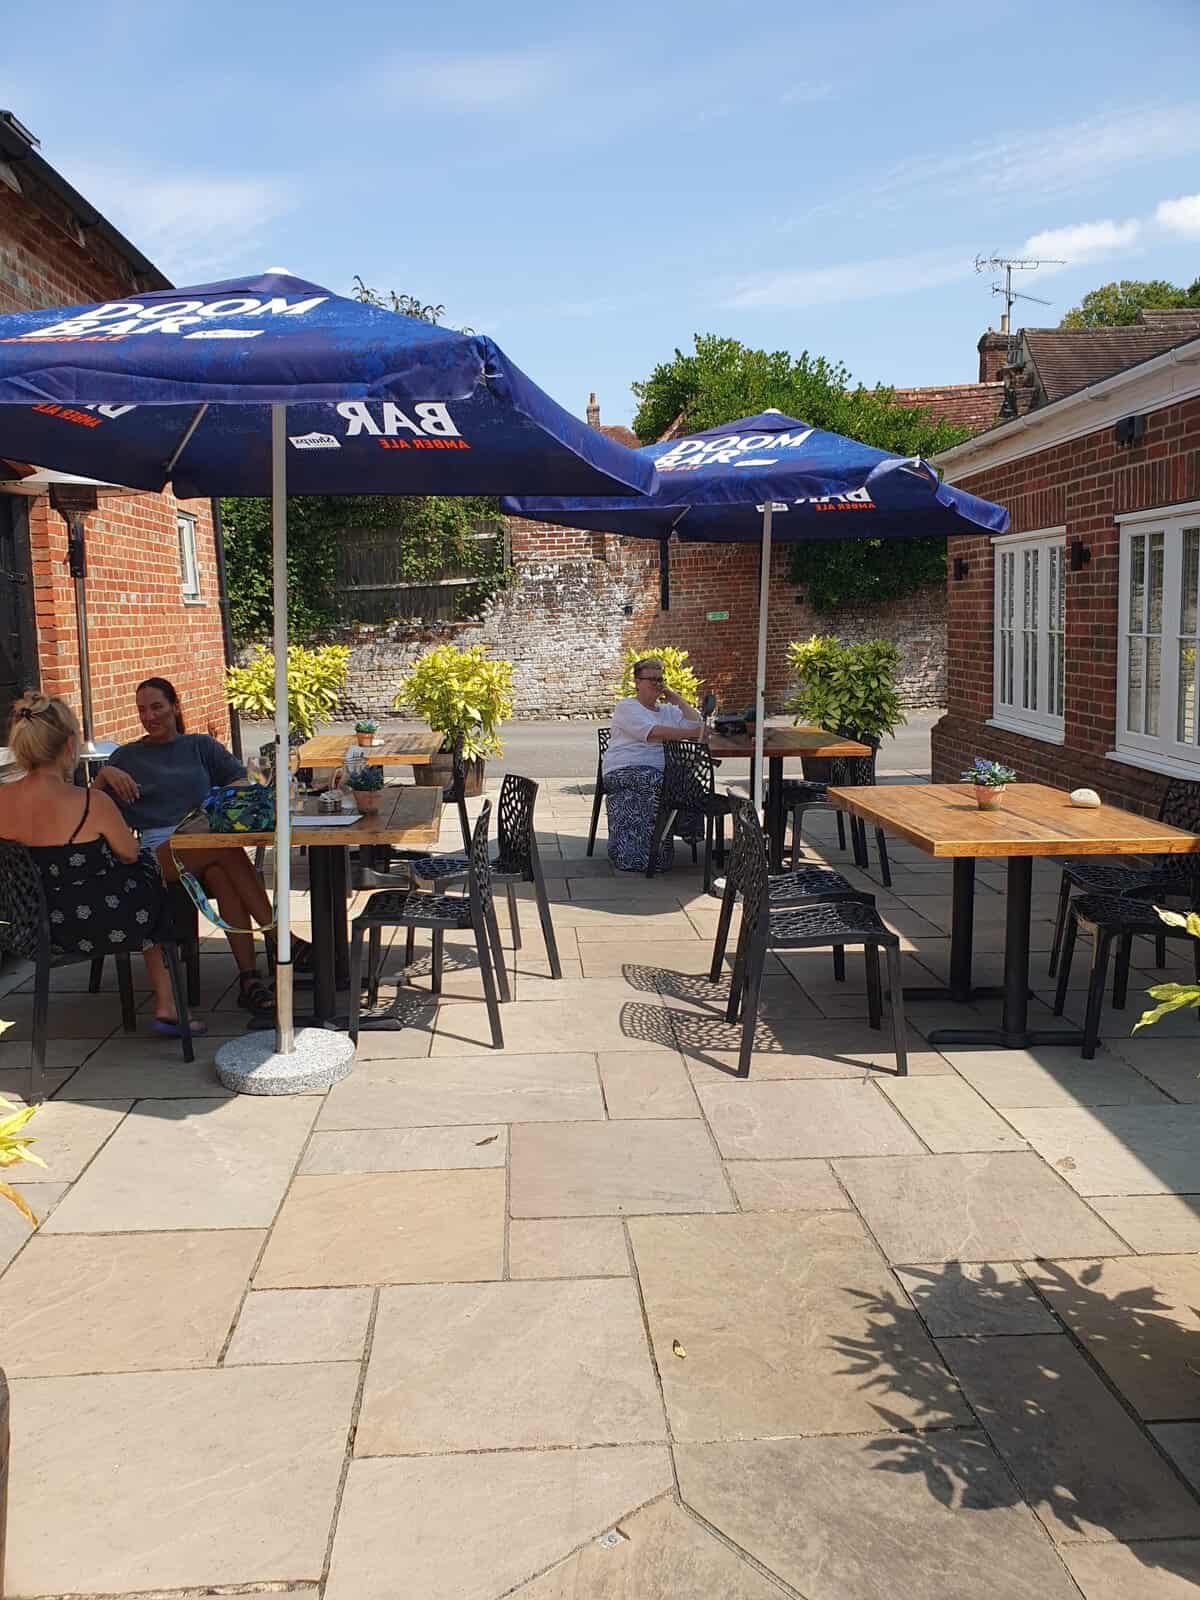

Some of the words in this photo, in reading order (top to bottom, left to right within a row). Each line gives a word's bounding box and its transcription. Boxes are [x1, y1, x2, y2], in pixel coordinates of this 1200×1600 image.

[74, 297, 328, 320] DOOM
[19, 316, 202, 338] BAR
[666, 428, 814, 455] DOOM
[654, 450, 741, 468] BAR
